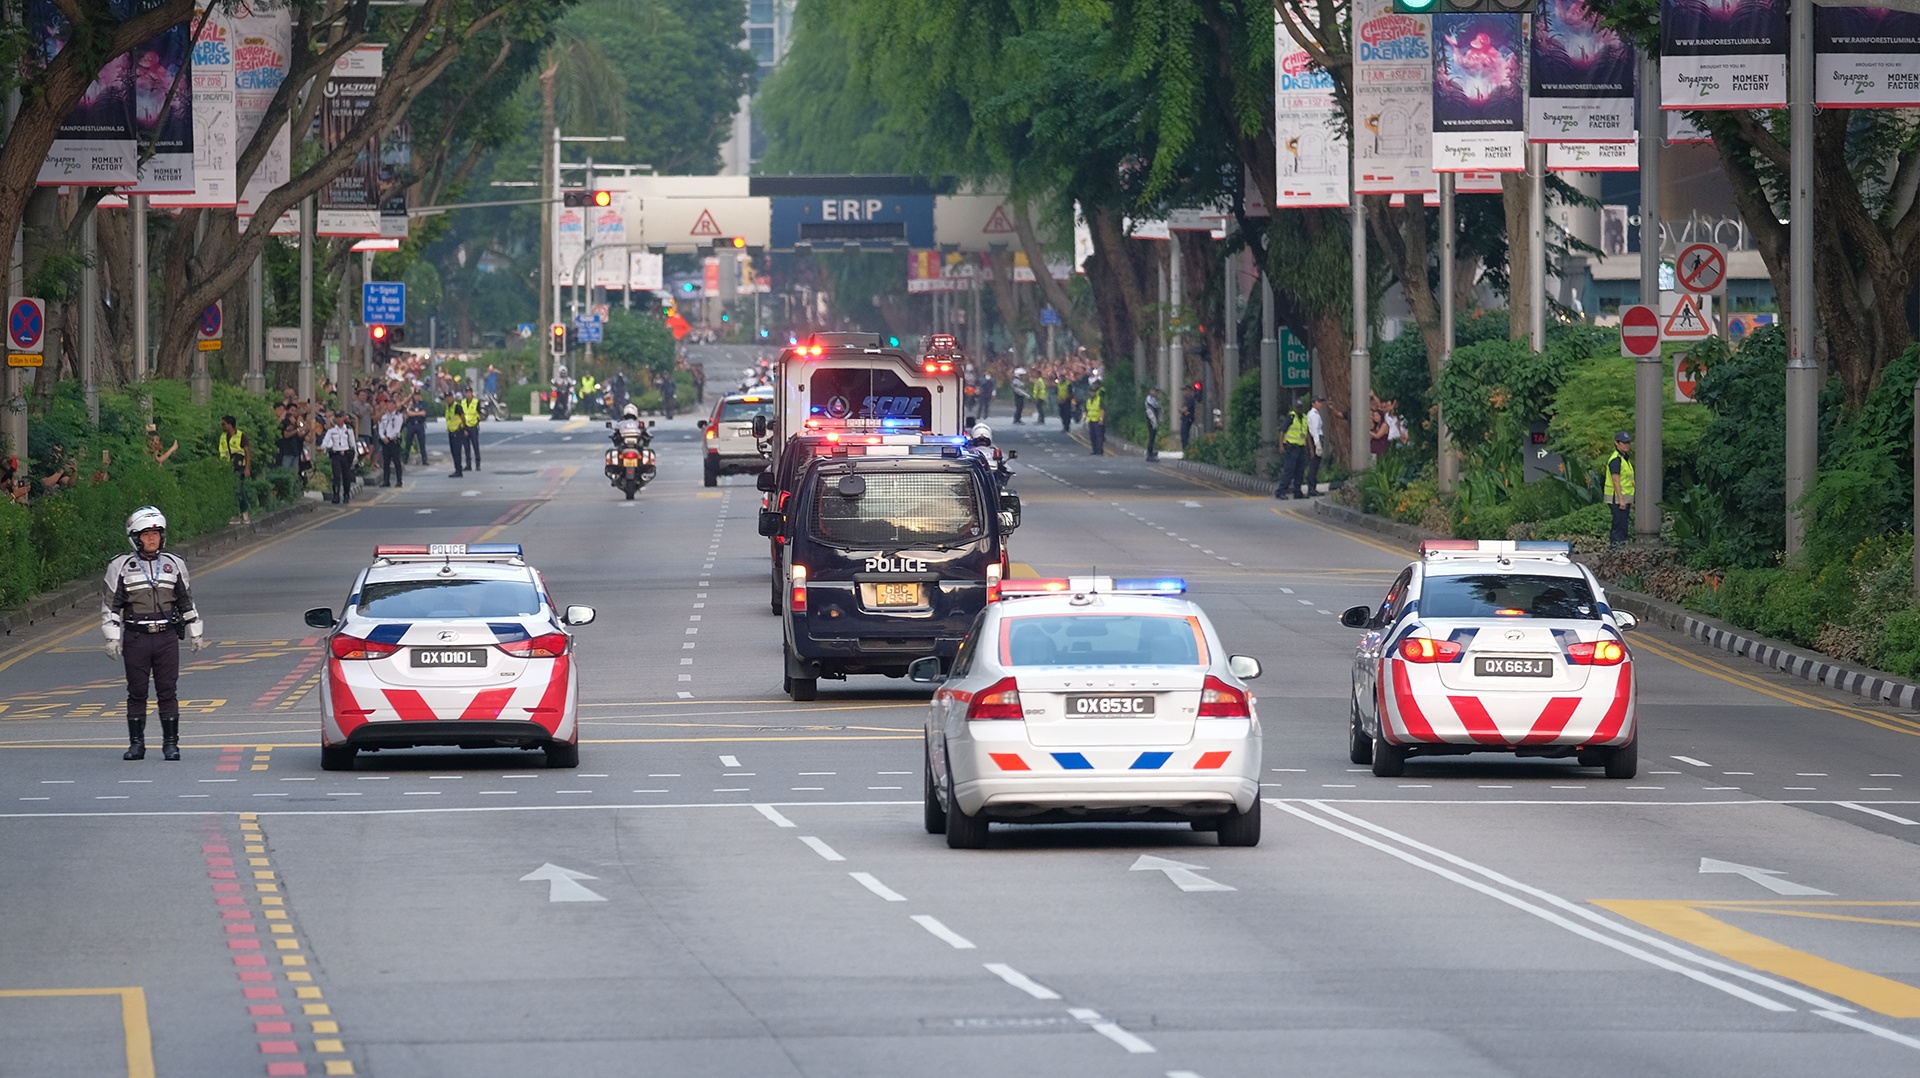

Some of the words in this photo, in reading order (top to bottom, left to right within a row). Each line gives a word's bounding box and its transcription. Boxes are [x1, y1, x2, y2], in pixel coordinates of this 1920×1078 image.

[1372, 20, 1425, 46] FESTIVAL
[1404, 36, 1426, 48] BIG
[1675, 38, 1771, 46] WWW.RAINFORESTLUMINA.SG
[194, 77, 205, 86] SEP
[207, 77, 222, 86] 2018
[1678, 73, 1713, 88] Singapore
[1732, 74, 1769, 82] MOMENT
[1833, 70, 1869, 86] Singapore
[340, 83, 377, 91] ULTRA
[1700, 83, 1719, 96] Zoo
[1855, 81, 1875, 94] Zoo
[1543, 112, 1573, 125] Singapore
[1589, 114, 1620, 122] MOMENT
[1561, 121, 1578, 132] Zoo
[1445, 146, 1471, 156] Singapore
[1560, 143, 1586, 154] Singapore
[1461, 152, 1476, 162] Zoo
[1576, 151, 1590, 160] Zoo
[46, 156, 76, 168] Singapore
[64, 164, 81, 174] Zoo
[862, 396, 923, 415] SCDF
[848, 419, 881, 427] POLICE
[432, 544, 465, 555] POLICE
[866, 558, 928, 572] POLICE
[886, 584, 909, 594] GBC
[1076, 698, 1144, 713] QX853C
